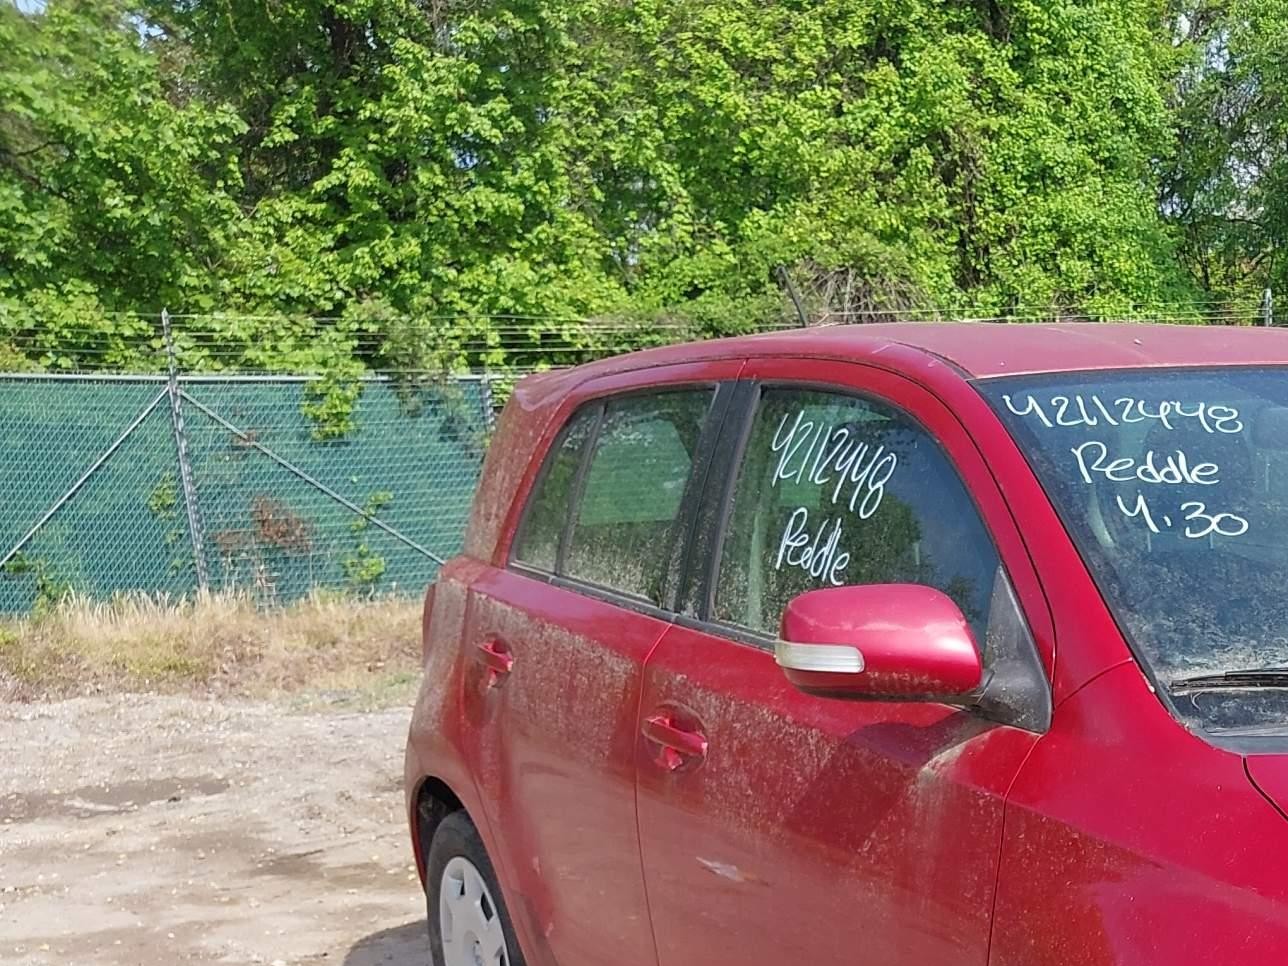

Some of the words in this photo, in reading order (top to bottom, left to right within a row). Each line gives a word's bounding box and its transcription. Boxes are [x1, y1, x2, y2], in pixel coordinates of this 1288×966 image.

[1002, 394, 1244, 433] 42112448
[771, 410, 897, 519] 42112448
[775, 506, 851, 586] Peddle
[1116, 493, 1250, 538] 4.30
